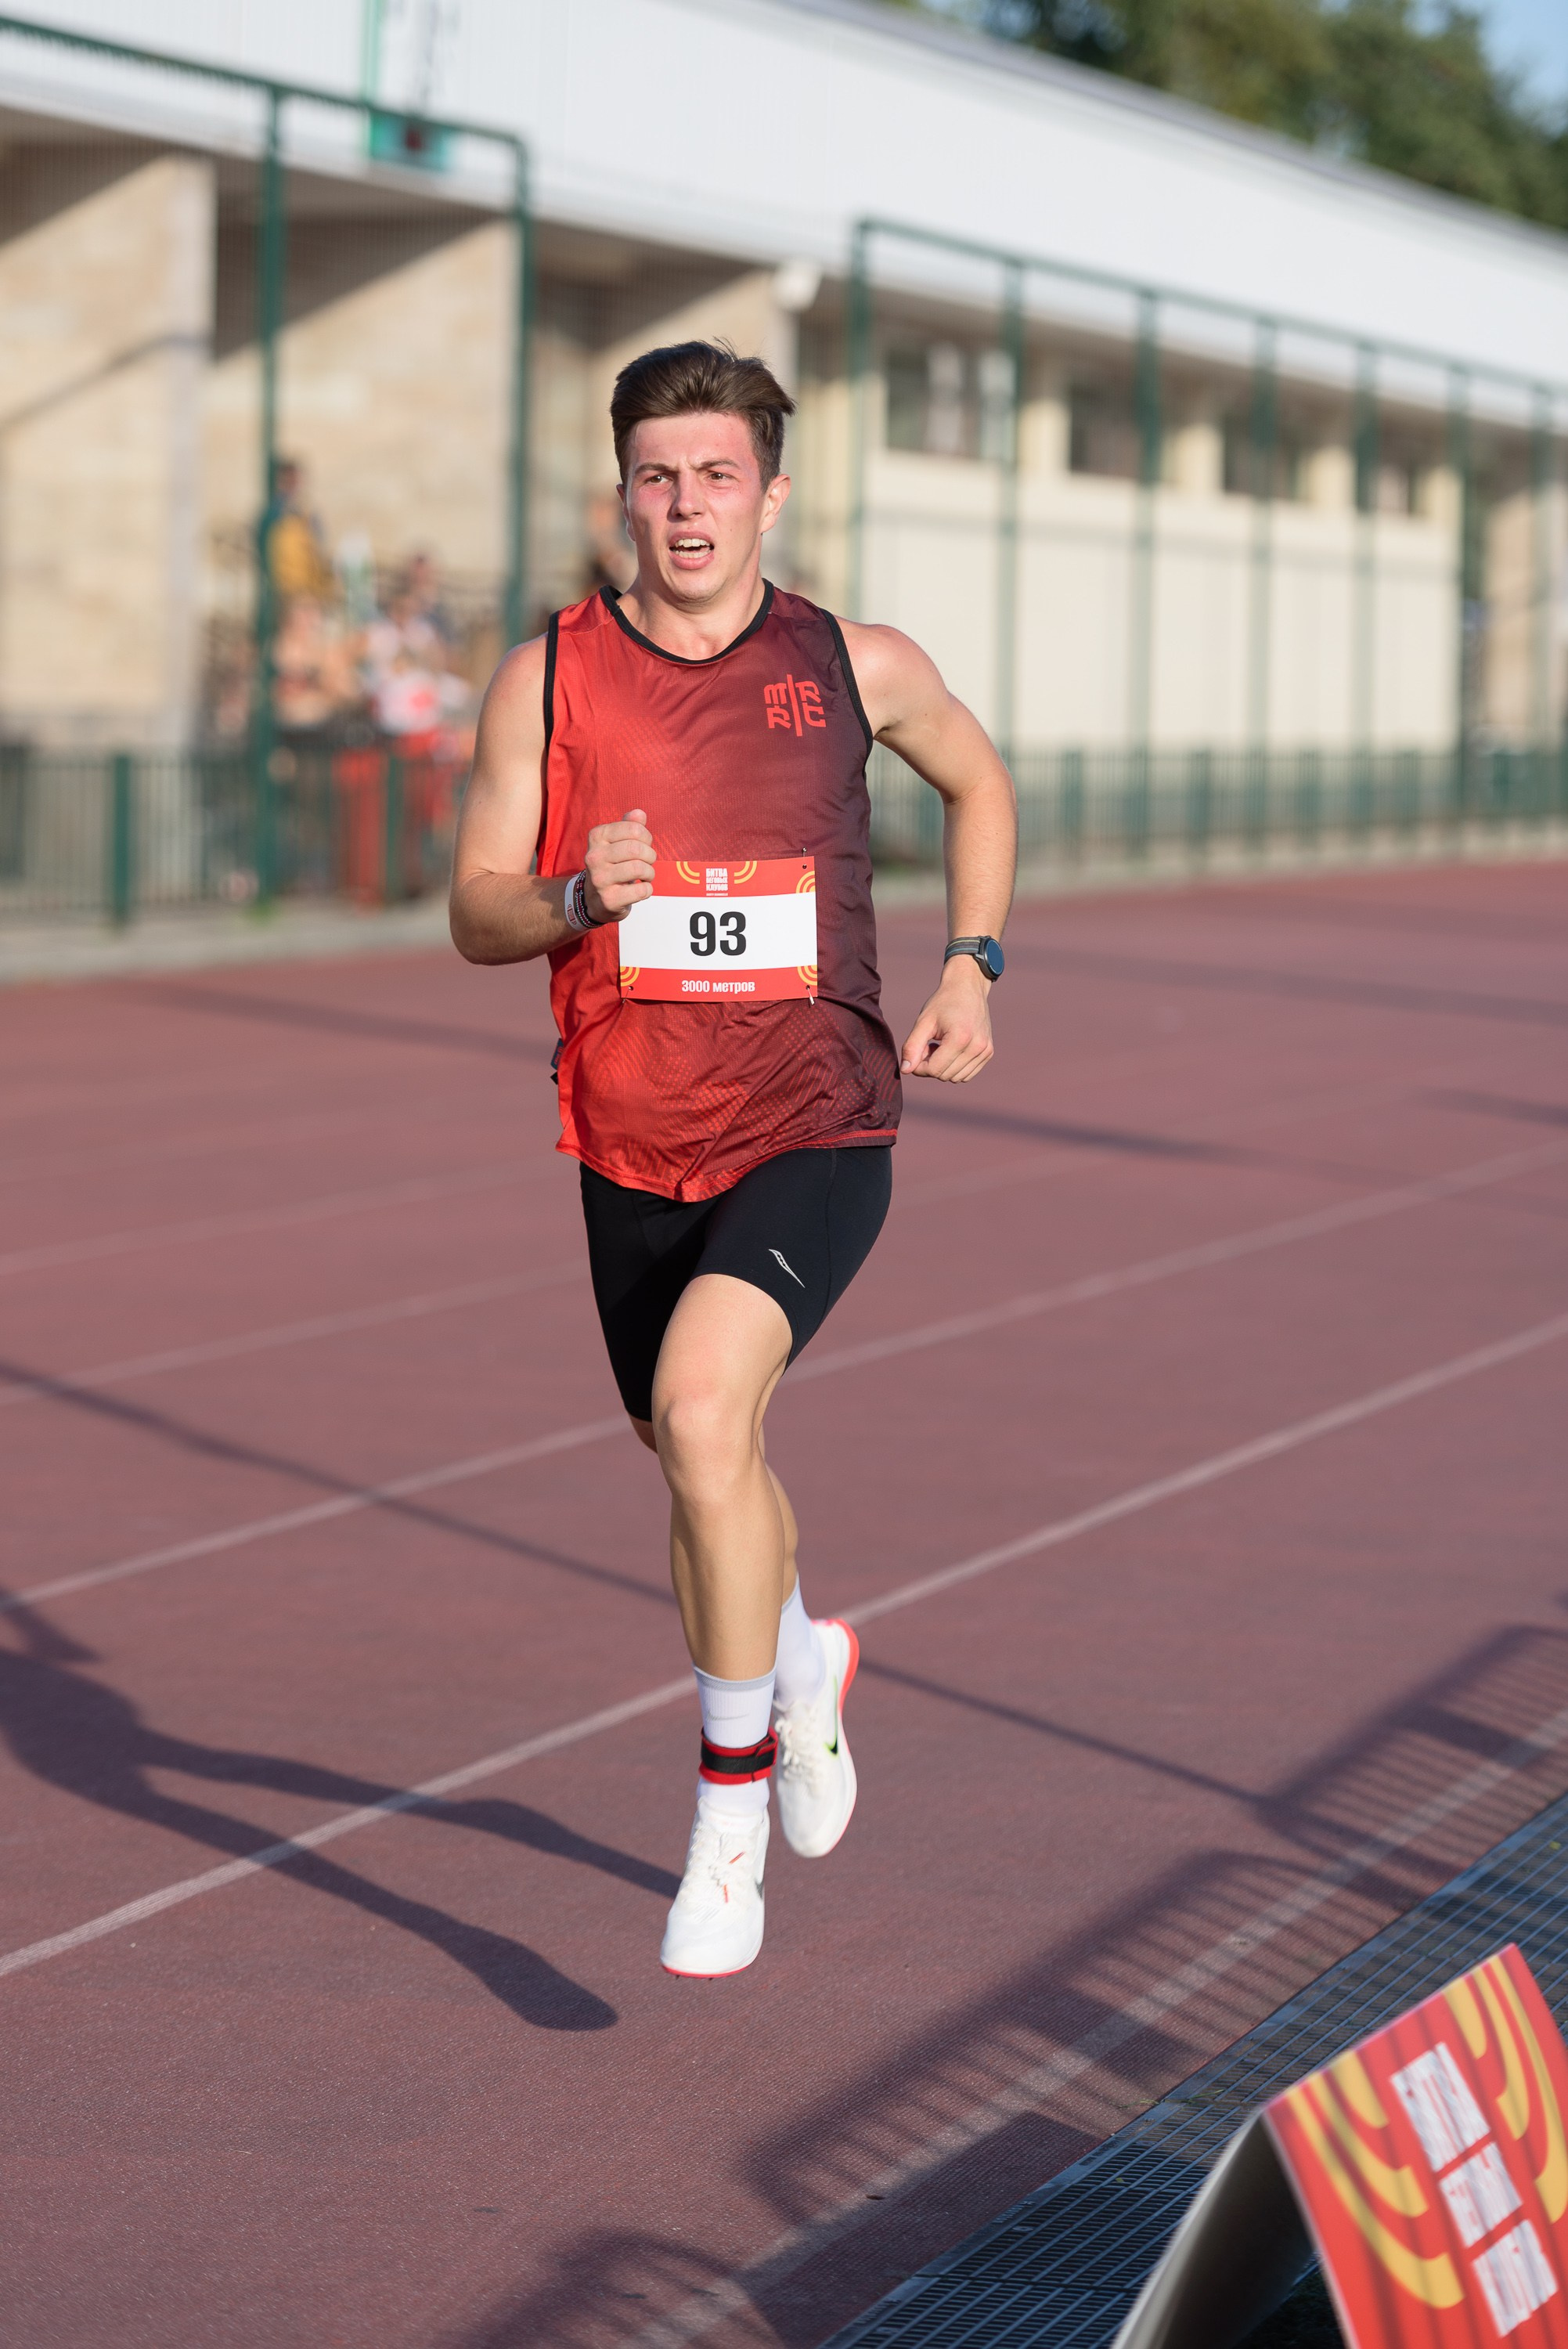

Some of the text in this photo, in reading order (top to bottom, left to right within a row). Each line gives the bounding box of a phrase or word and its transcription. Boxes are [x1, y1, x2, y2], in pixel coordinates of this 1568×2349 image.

[690, 911, 747, 956] 93
[681, 980, 755, 994] 3000 метров
